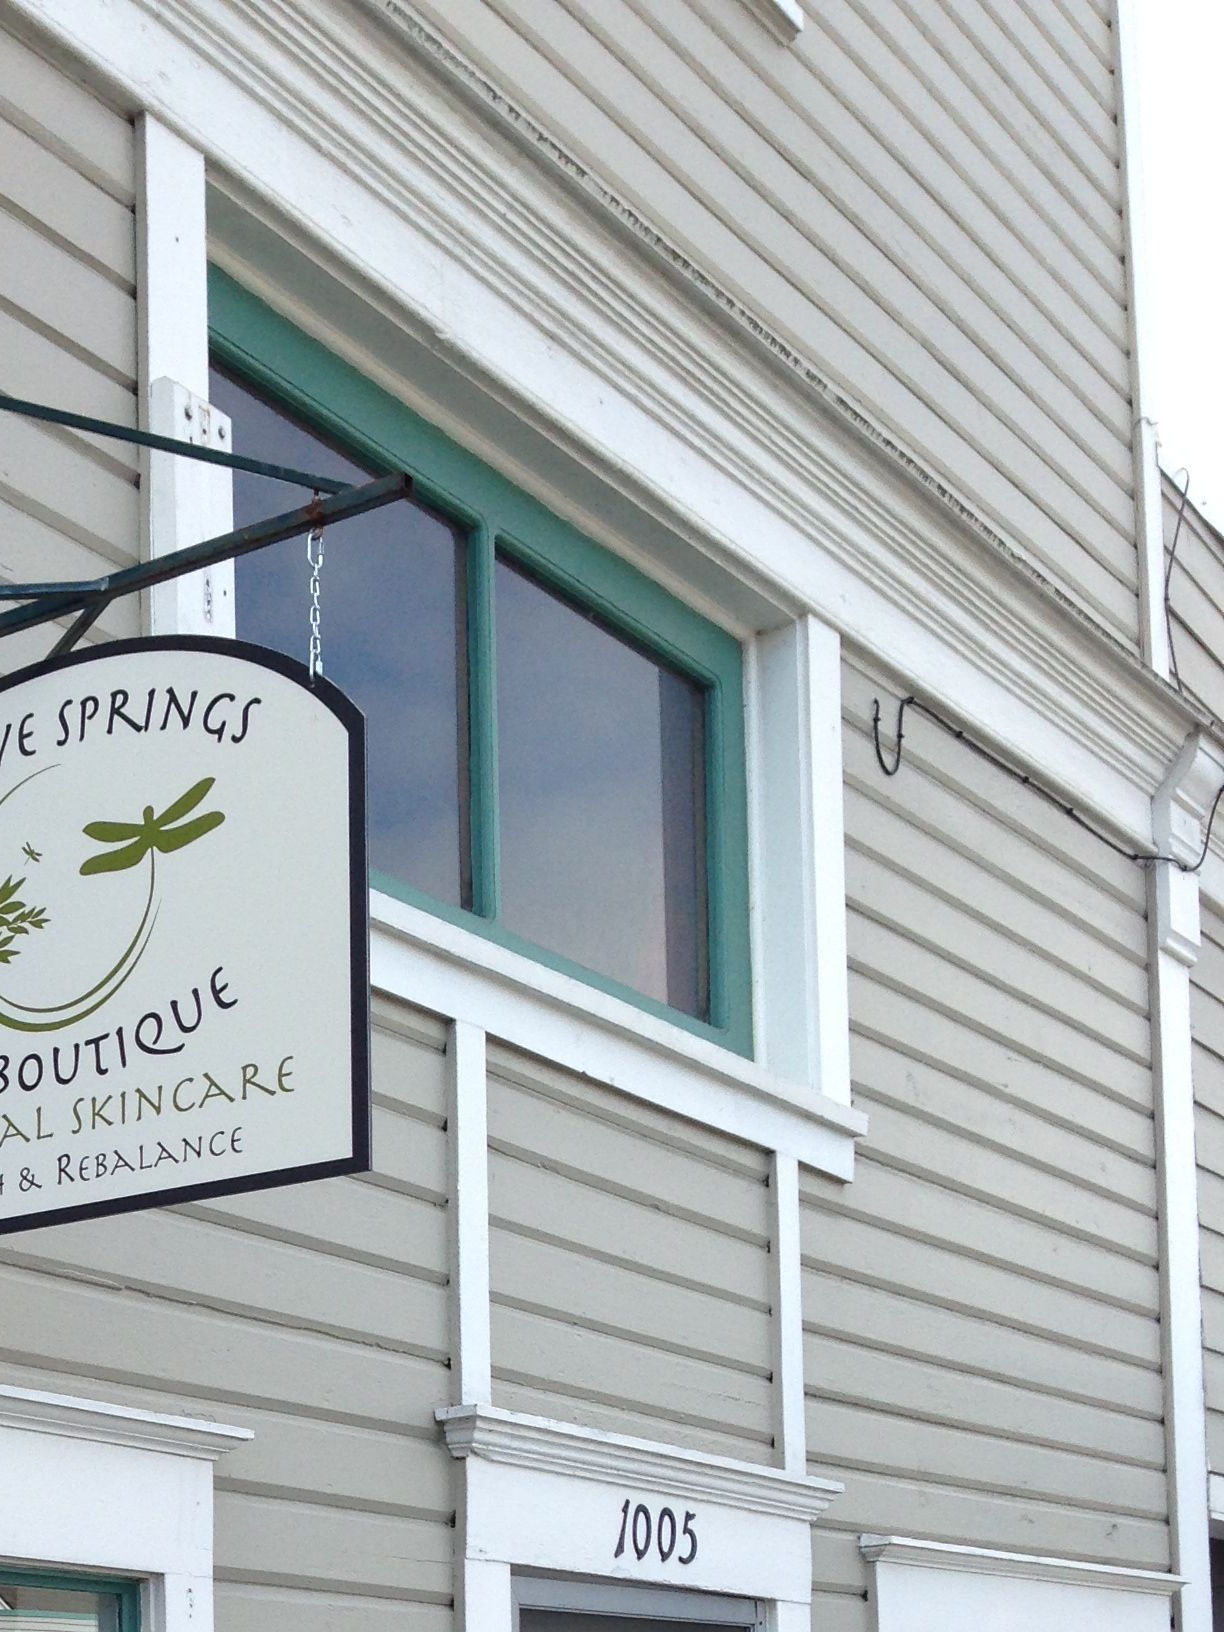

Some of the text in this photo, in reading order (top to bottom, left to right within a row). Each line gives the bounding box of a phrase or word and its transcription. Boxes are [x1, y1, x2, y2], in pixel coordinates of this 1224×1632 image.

[56, 686, 262, 747] SPRINGS
[72, 1056, 296, 1136] SKINCARE
[18, 1167, 43, 1192] &
[57, 1127, 245, 1187] REBALANCE
[614, 1498, 698, 1564] 1005
